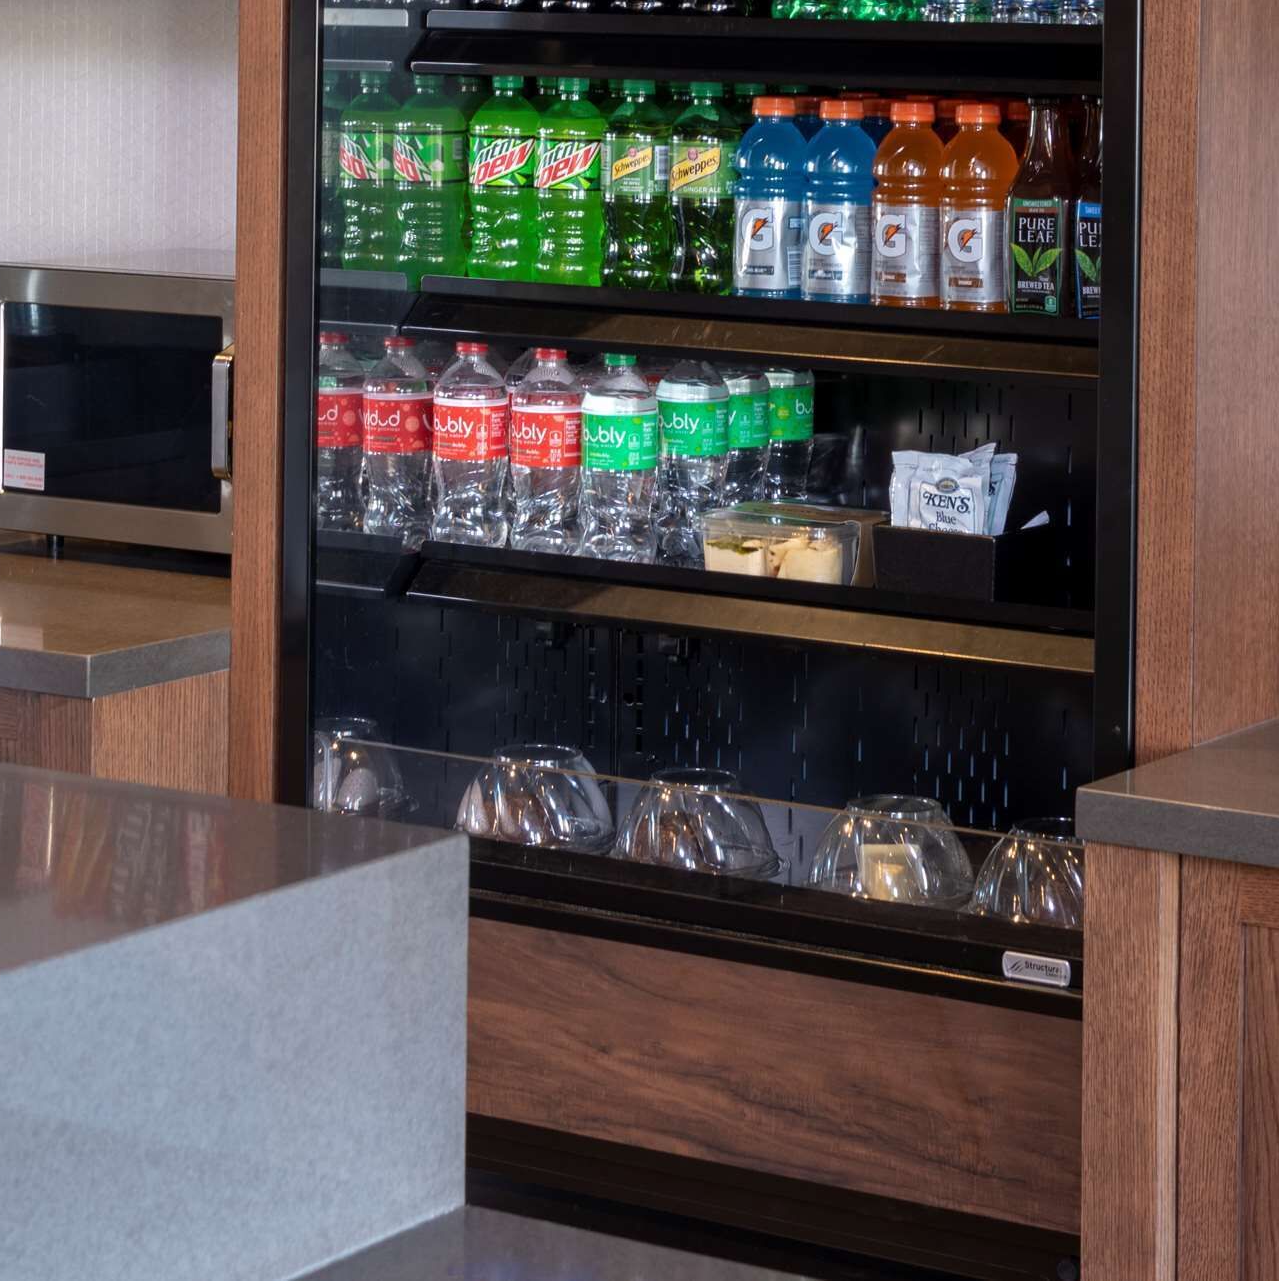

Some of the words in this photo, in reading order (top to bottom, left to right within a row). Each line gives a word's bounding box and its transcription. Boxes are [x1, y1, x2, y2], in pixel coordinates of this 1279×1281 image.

[614, 156, 650, 176] Schweppes
[671, 158, 718, 186] Schweppes
[741, 208, 774, 251] G
[809, 212, 846, 255] G
[875, 214, 907, 257] G
[1019, 217, 1056, 231] PURE
[948, 218, 983, 263] G
[1018, 230, 1053, 243] LEAF
[1017, 281, 1043, 289] BREWED
[1043, 282, 1055, 290] TEA
[434, 410, 475, 438] bubly
[583, 426, 626, 449] bubly
[923, 492, 971, 514] KEN'S
[936, 511, 957, 525] Blue
